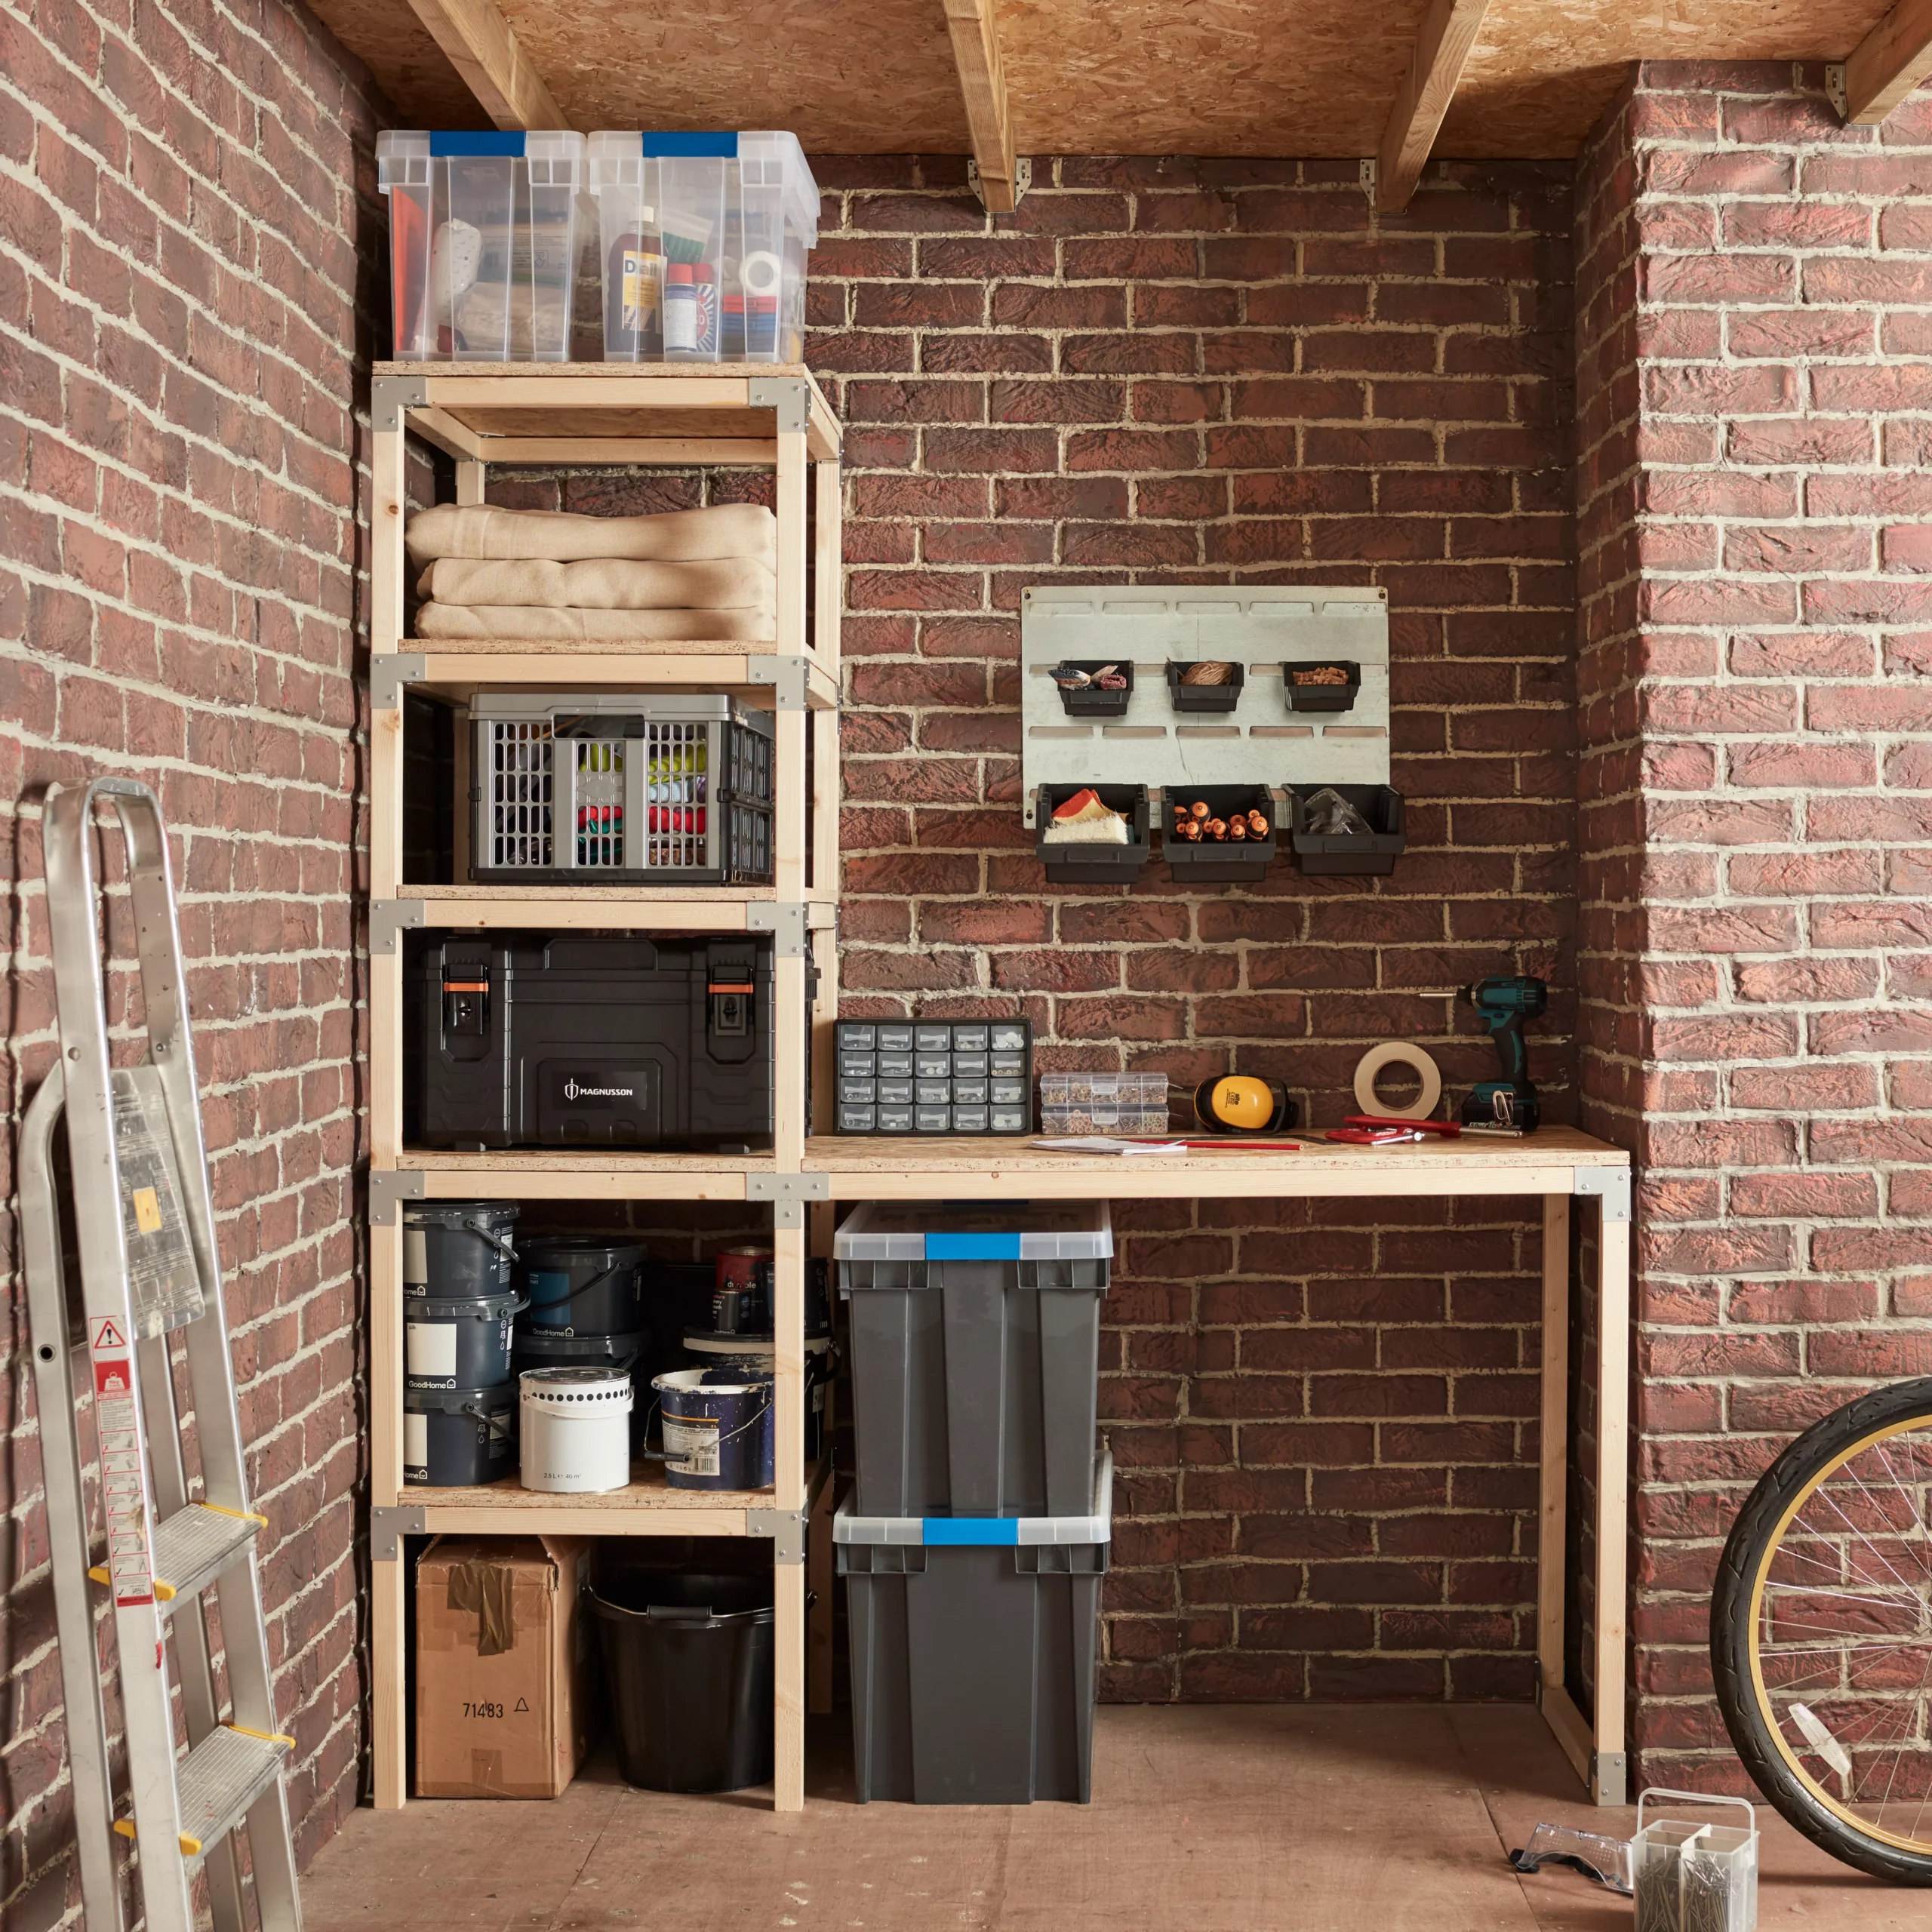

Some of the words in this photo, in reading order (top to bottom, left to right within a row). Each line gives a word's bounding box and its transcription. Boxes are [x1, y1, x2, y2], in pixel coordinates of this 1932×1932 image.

[625, 259, 657, 276] Dall
[533, 1328, 565, 1337] GoodHome
[408, 1380, 446, 1389] GoodHome
[463, 1703, 503, 1718] 71483
